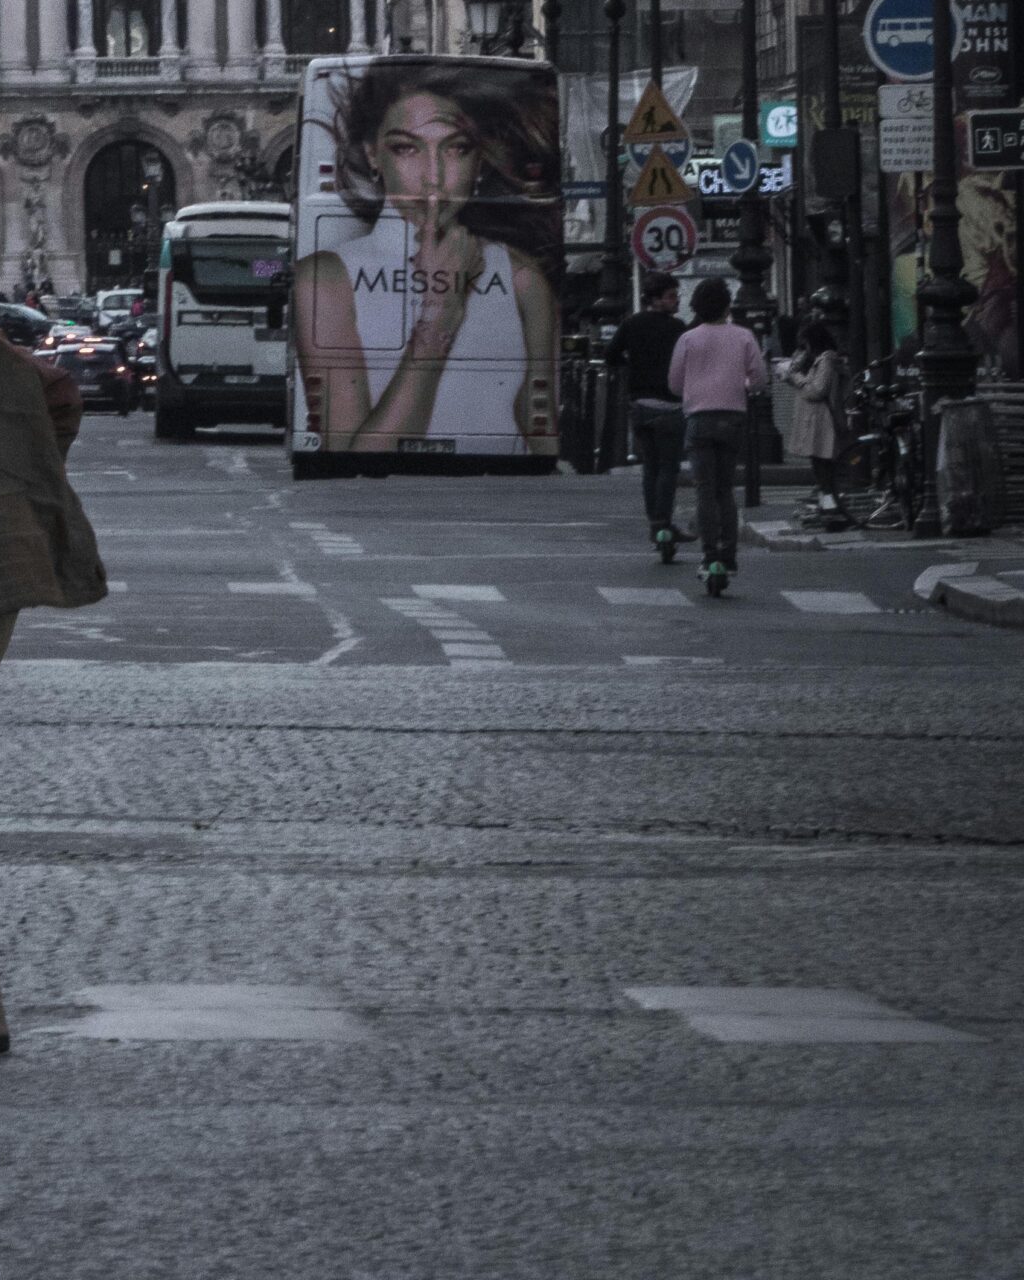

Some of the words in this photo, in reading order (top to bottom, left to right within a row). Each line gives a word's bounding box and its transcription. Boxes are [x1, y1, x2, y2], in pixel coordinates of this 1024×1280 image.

[699, 166, 785, 194] CHGE
[647, 224, 684, 253] 30
[354, 267, 508, 296] MESSIKA
